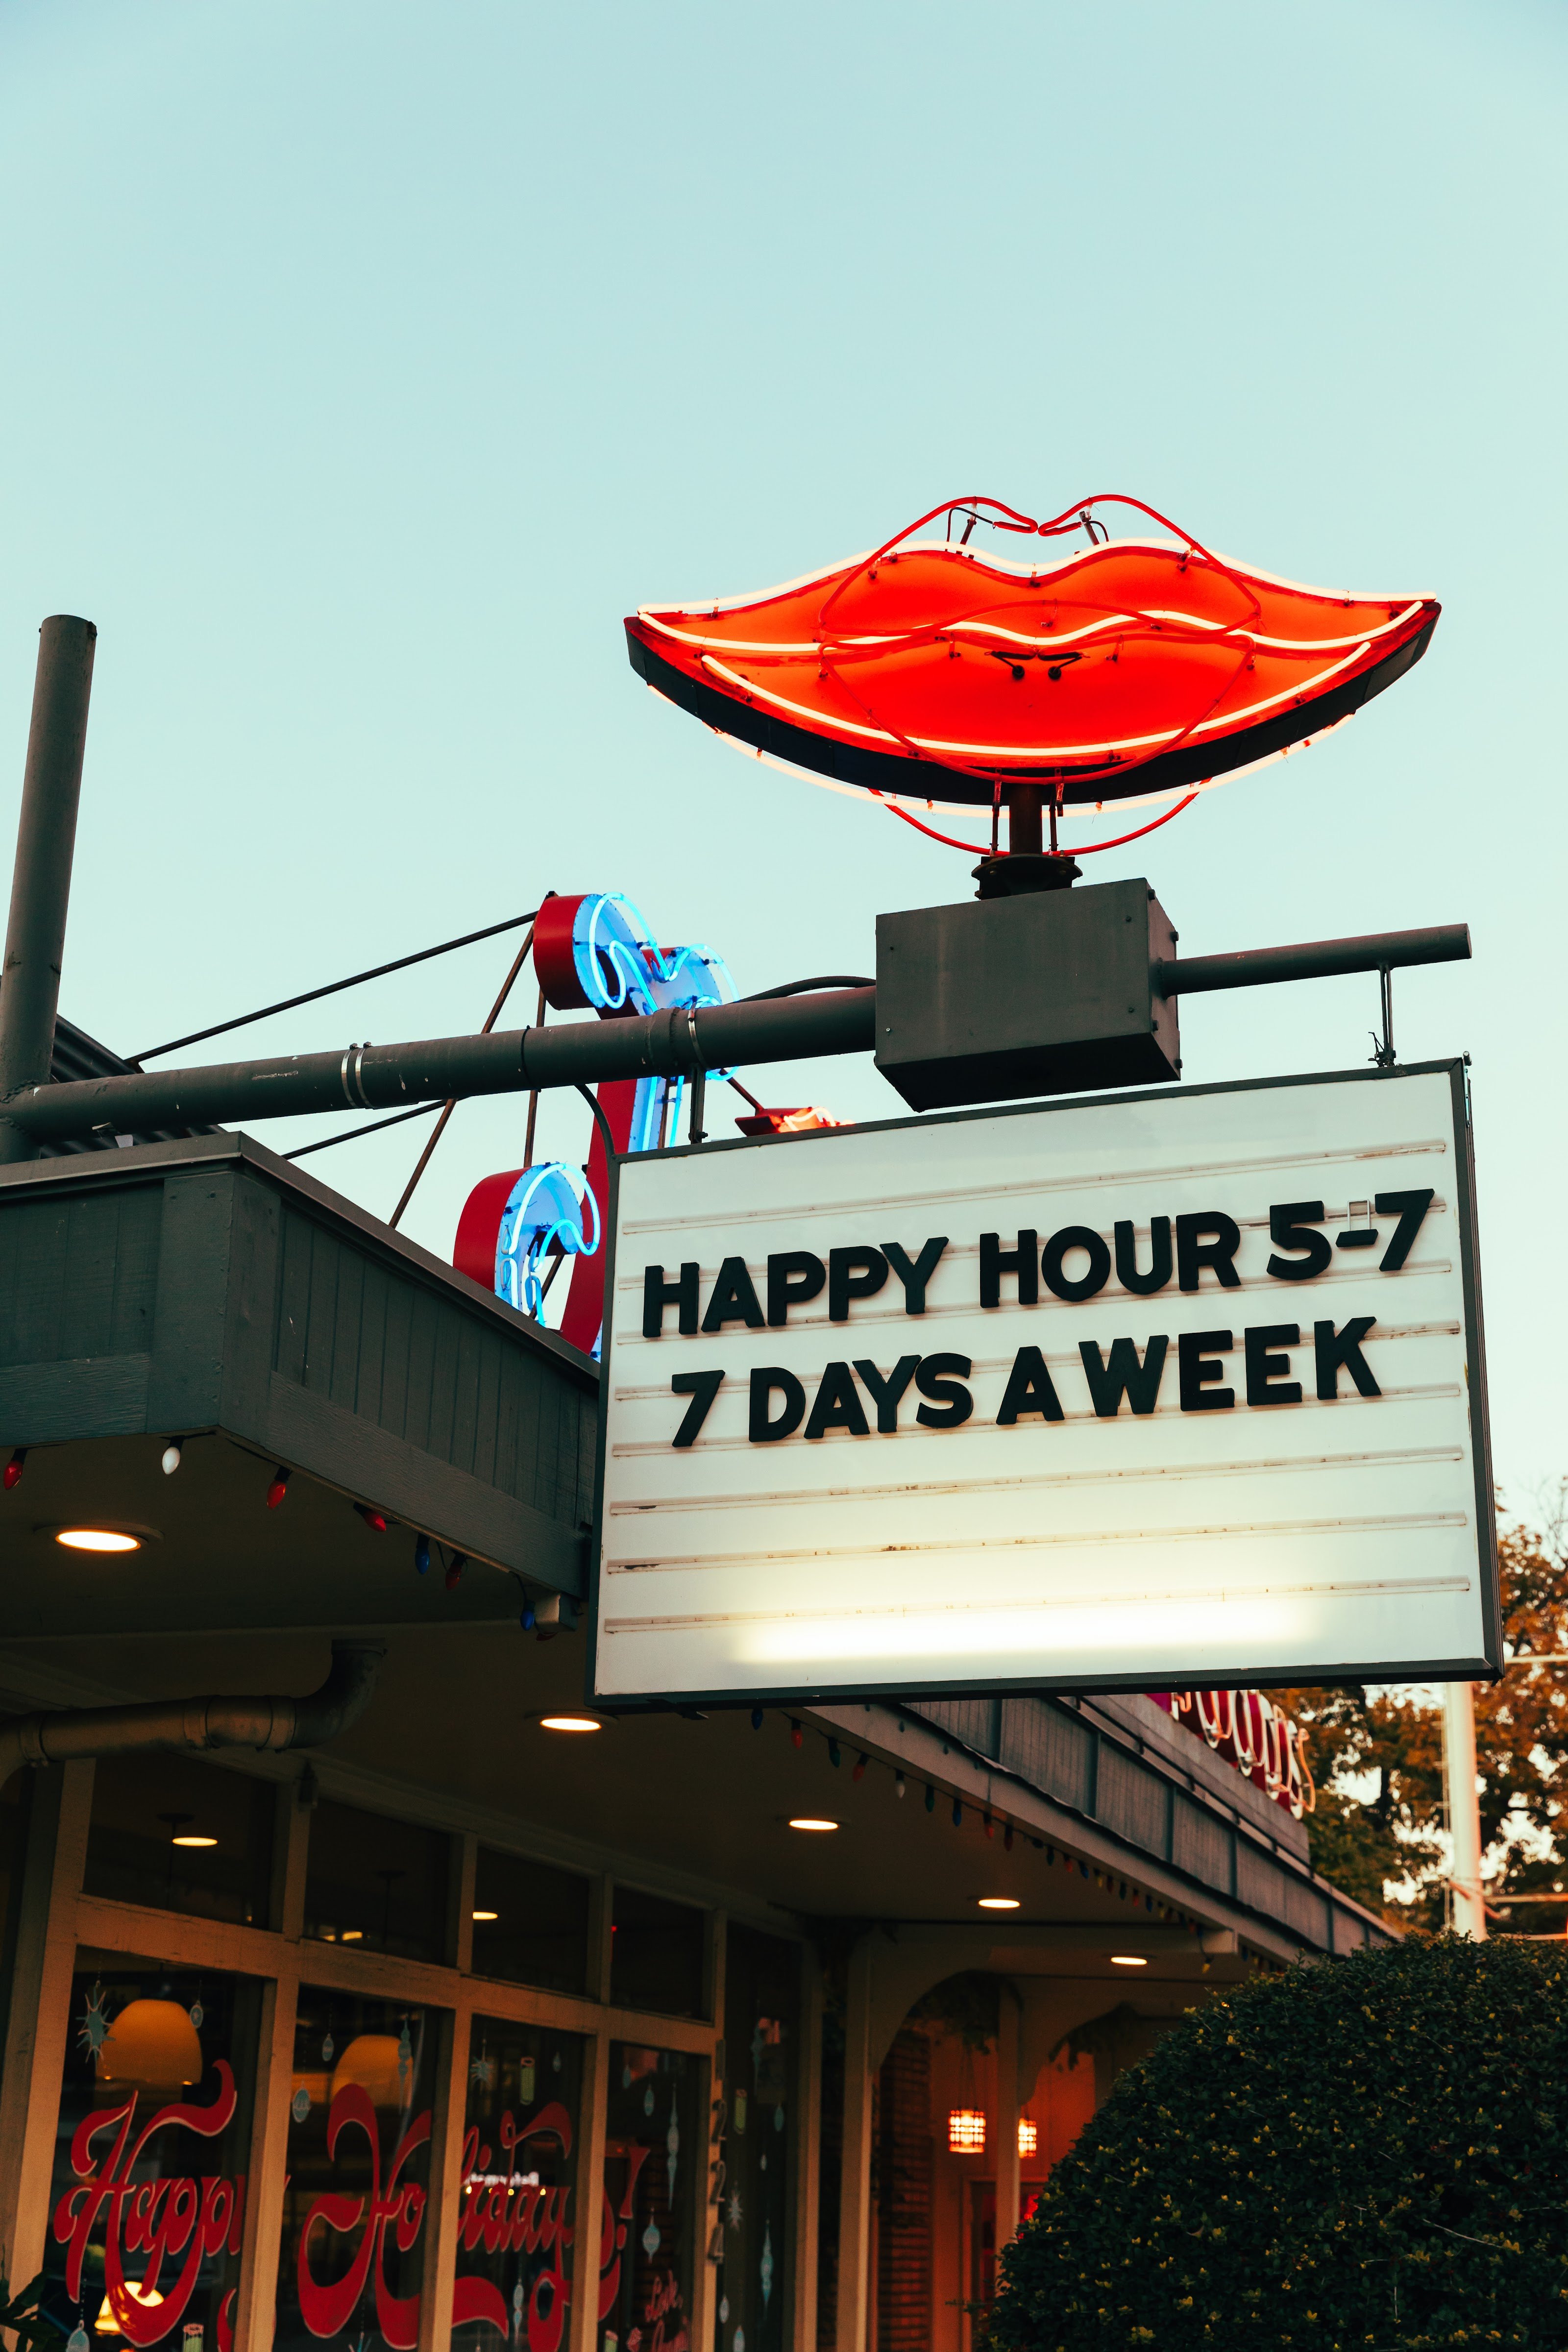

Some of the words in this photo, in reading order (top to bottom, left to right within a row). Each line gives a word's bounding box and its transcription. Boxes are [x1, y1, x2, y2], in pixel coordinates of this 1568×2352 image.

[642, 1236, 949, 1339] HAPPY
[980, 1211, 1241, 1309] HOUR
[1266, 1188, 1435, 1280] 5-7
[671, 1369, 726, 1447] 7
[748, 1352, 974, 1443] DAYS
[996, 1346, 1065, 1425] A
[1078, 1316, 1382, 1418] WEEK
